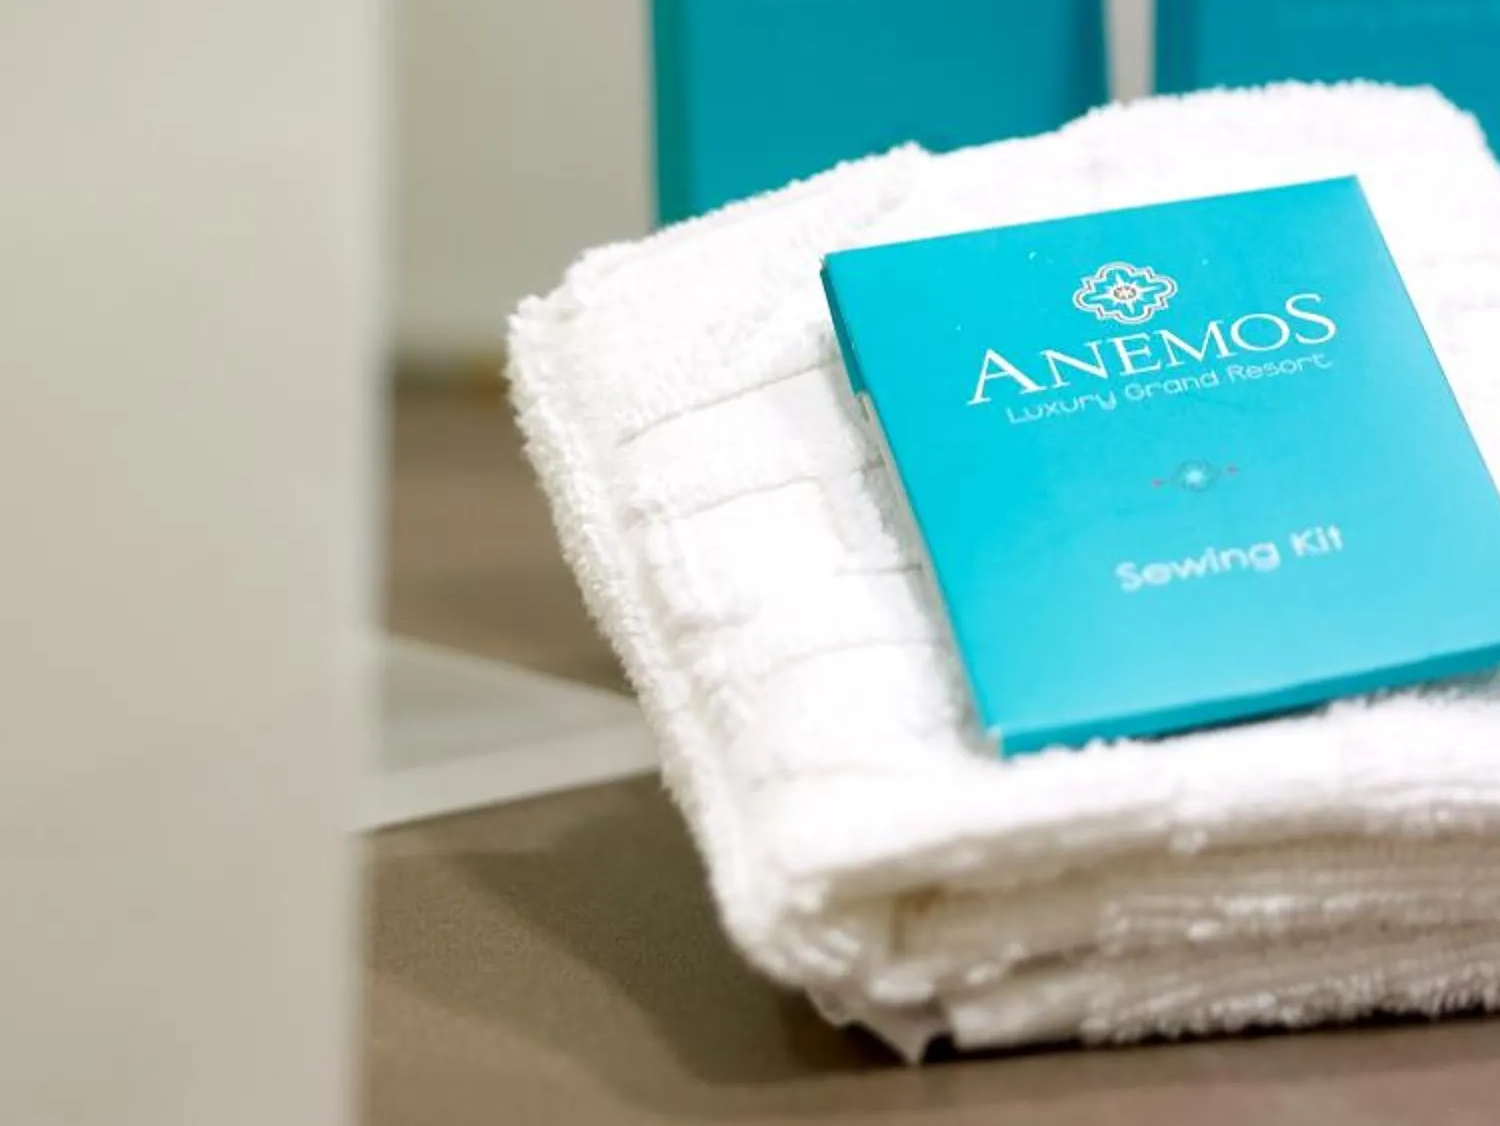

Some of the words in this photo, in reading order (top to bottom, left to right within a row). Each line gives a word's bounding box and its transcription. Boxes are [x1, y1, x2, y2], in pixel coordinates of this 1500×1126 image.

[966, 292, 1338, 406] ANEMOS
[1008, 387, 1117, 425] Luxury
[1125, 368, 1219, 401] Grand
[1226, 351, 1333, 382] Resort
[1114, 538, 1281, 592] Sewing
[1291, 525, 1343, 558] Kit
